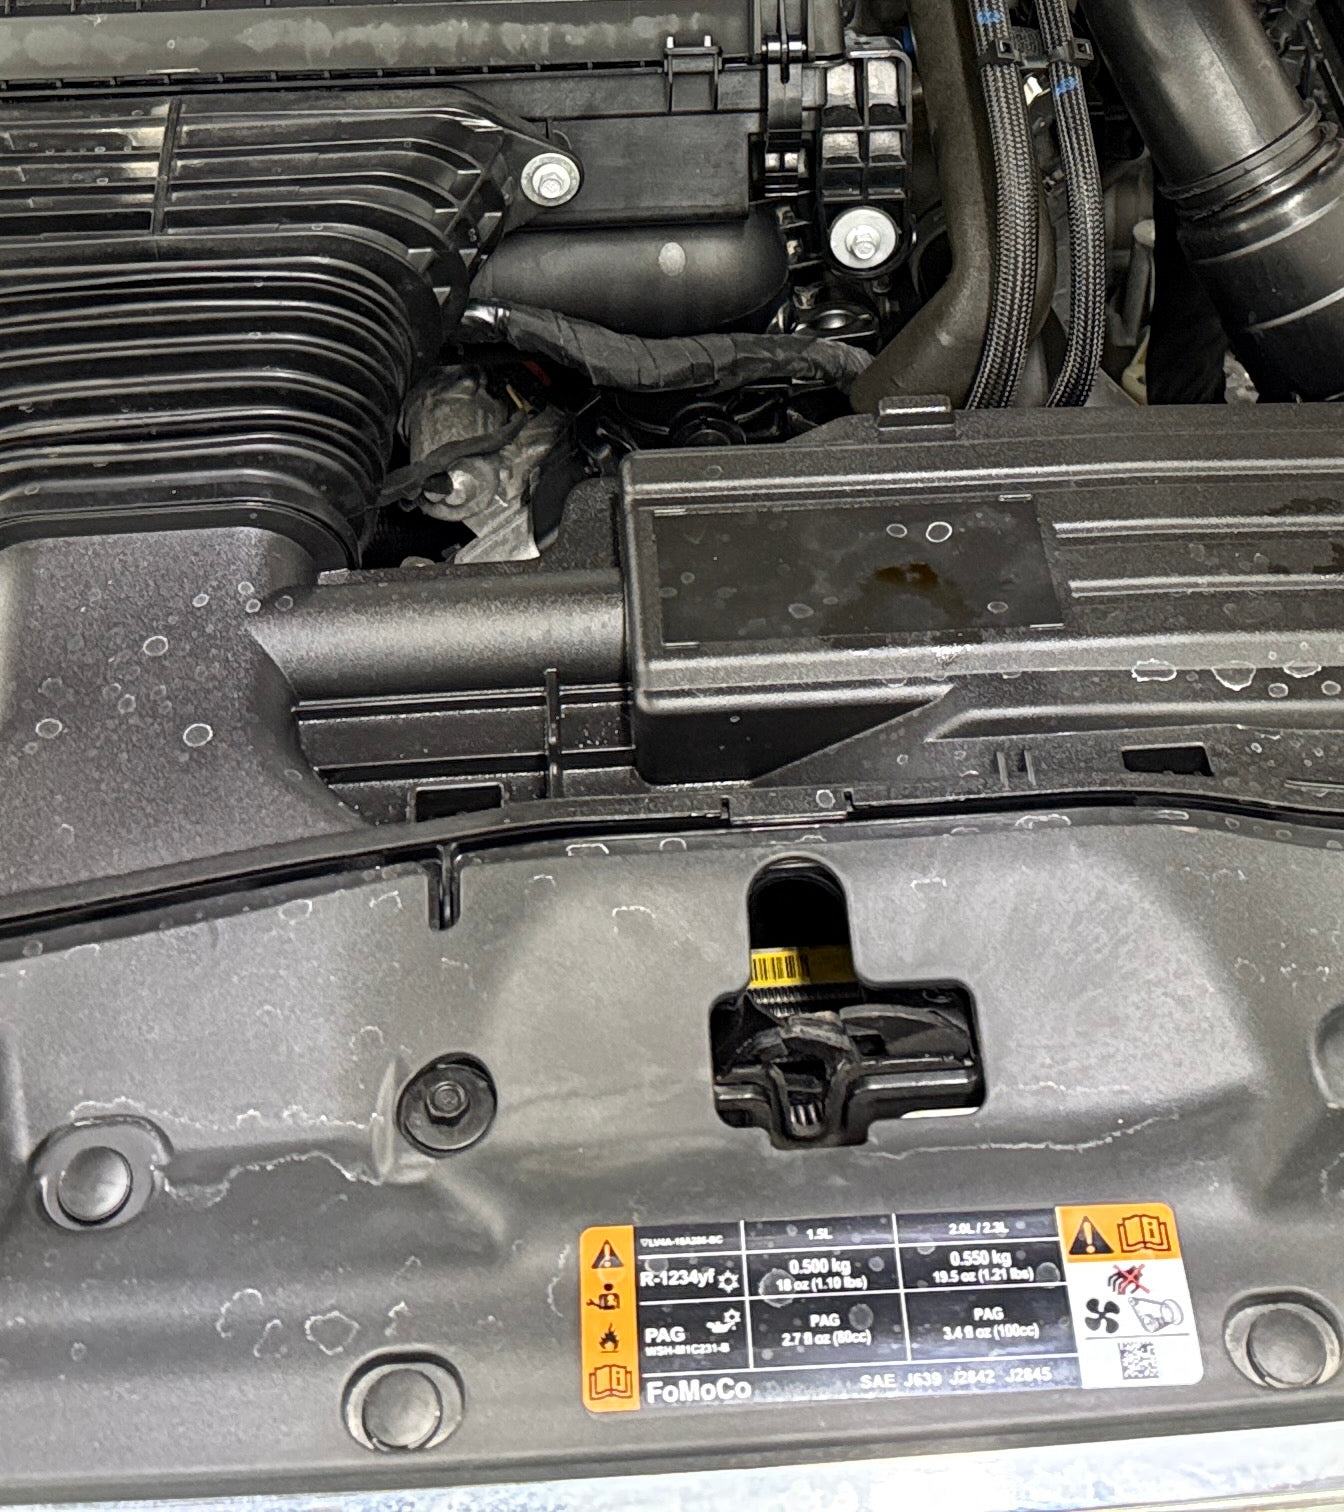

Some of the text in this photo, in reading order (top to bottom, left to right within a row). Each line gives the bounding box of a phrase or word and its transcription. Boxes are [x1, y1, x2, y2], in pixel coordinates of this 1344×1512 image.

[806, 1228, 834, 1240] 1.5L
[948, 1223, 975, 1235] 2.0L
[982, 1221, 1009, 1234] 2.3L
[789, 1257, 852, 1276] 0.500 kg
[949, 1249, 1012, 1268] 0.550 kg
[640, 1268, 716, 1288] R-1234yf
[932, 1266, 1035, 1283] 19.5 oz (1.21 lbs)
[794, 1279, 810, 1291] oz
[811, 1276, 842, 1292] (1.10
[843, 1275, 868, 1290] lbs)
[809, 1313, 841, 1327] PAG
[973, 1306, 1004, 1321] PAG
[644, 1326, 686, 1343] PAG
[781, 1333, 802, 1346] 2.7
[815, 1333, 831, 1345] oz
[942, 1326, 963, 1340] 3.4
[975, 1326, 993, 1338] oz
[993, 1322, 1040, 1340] (100cc)
[859, 1373, 896, 1389] SAE
[1004, 1366, 1053, 1383] J2845
[646, 1377, 752, 1404] FoMoCo
